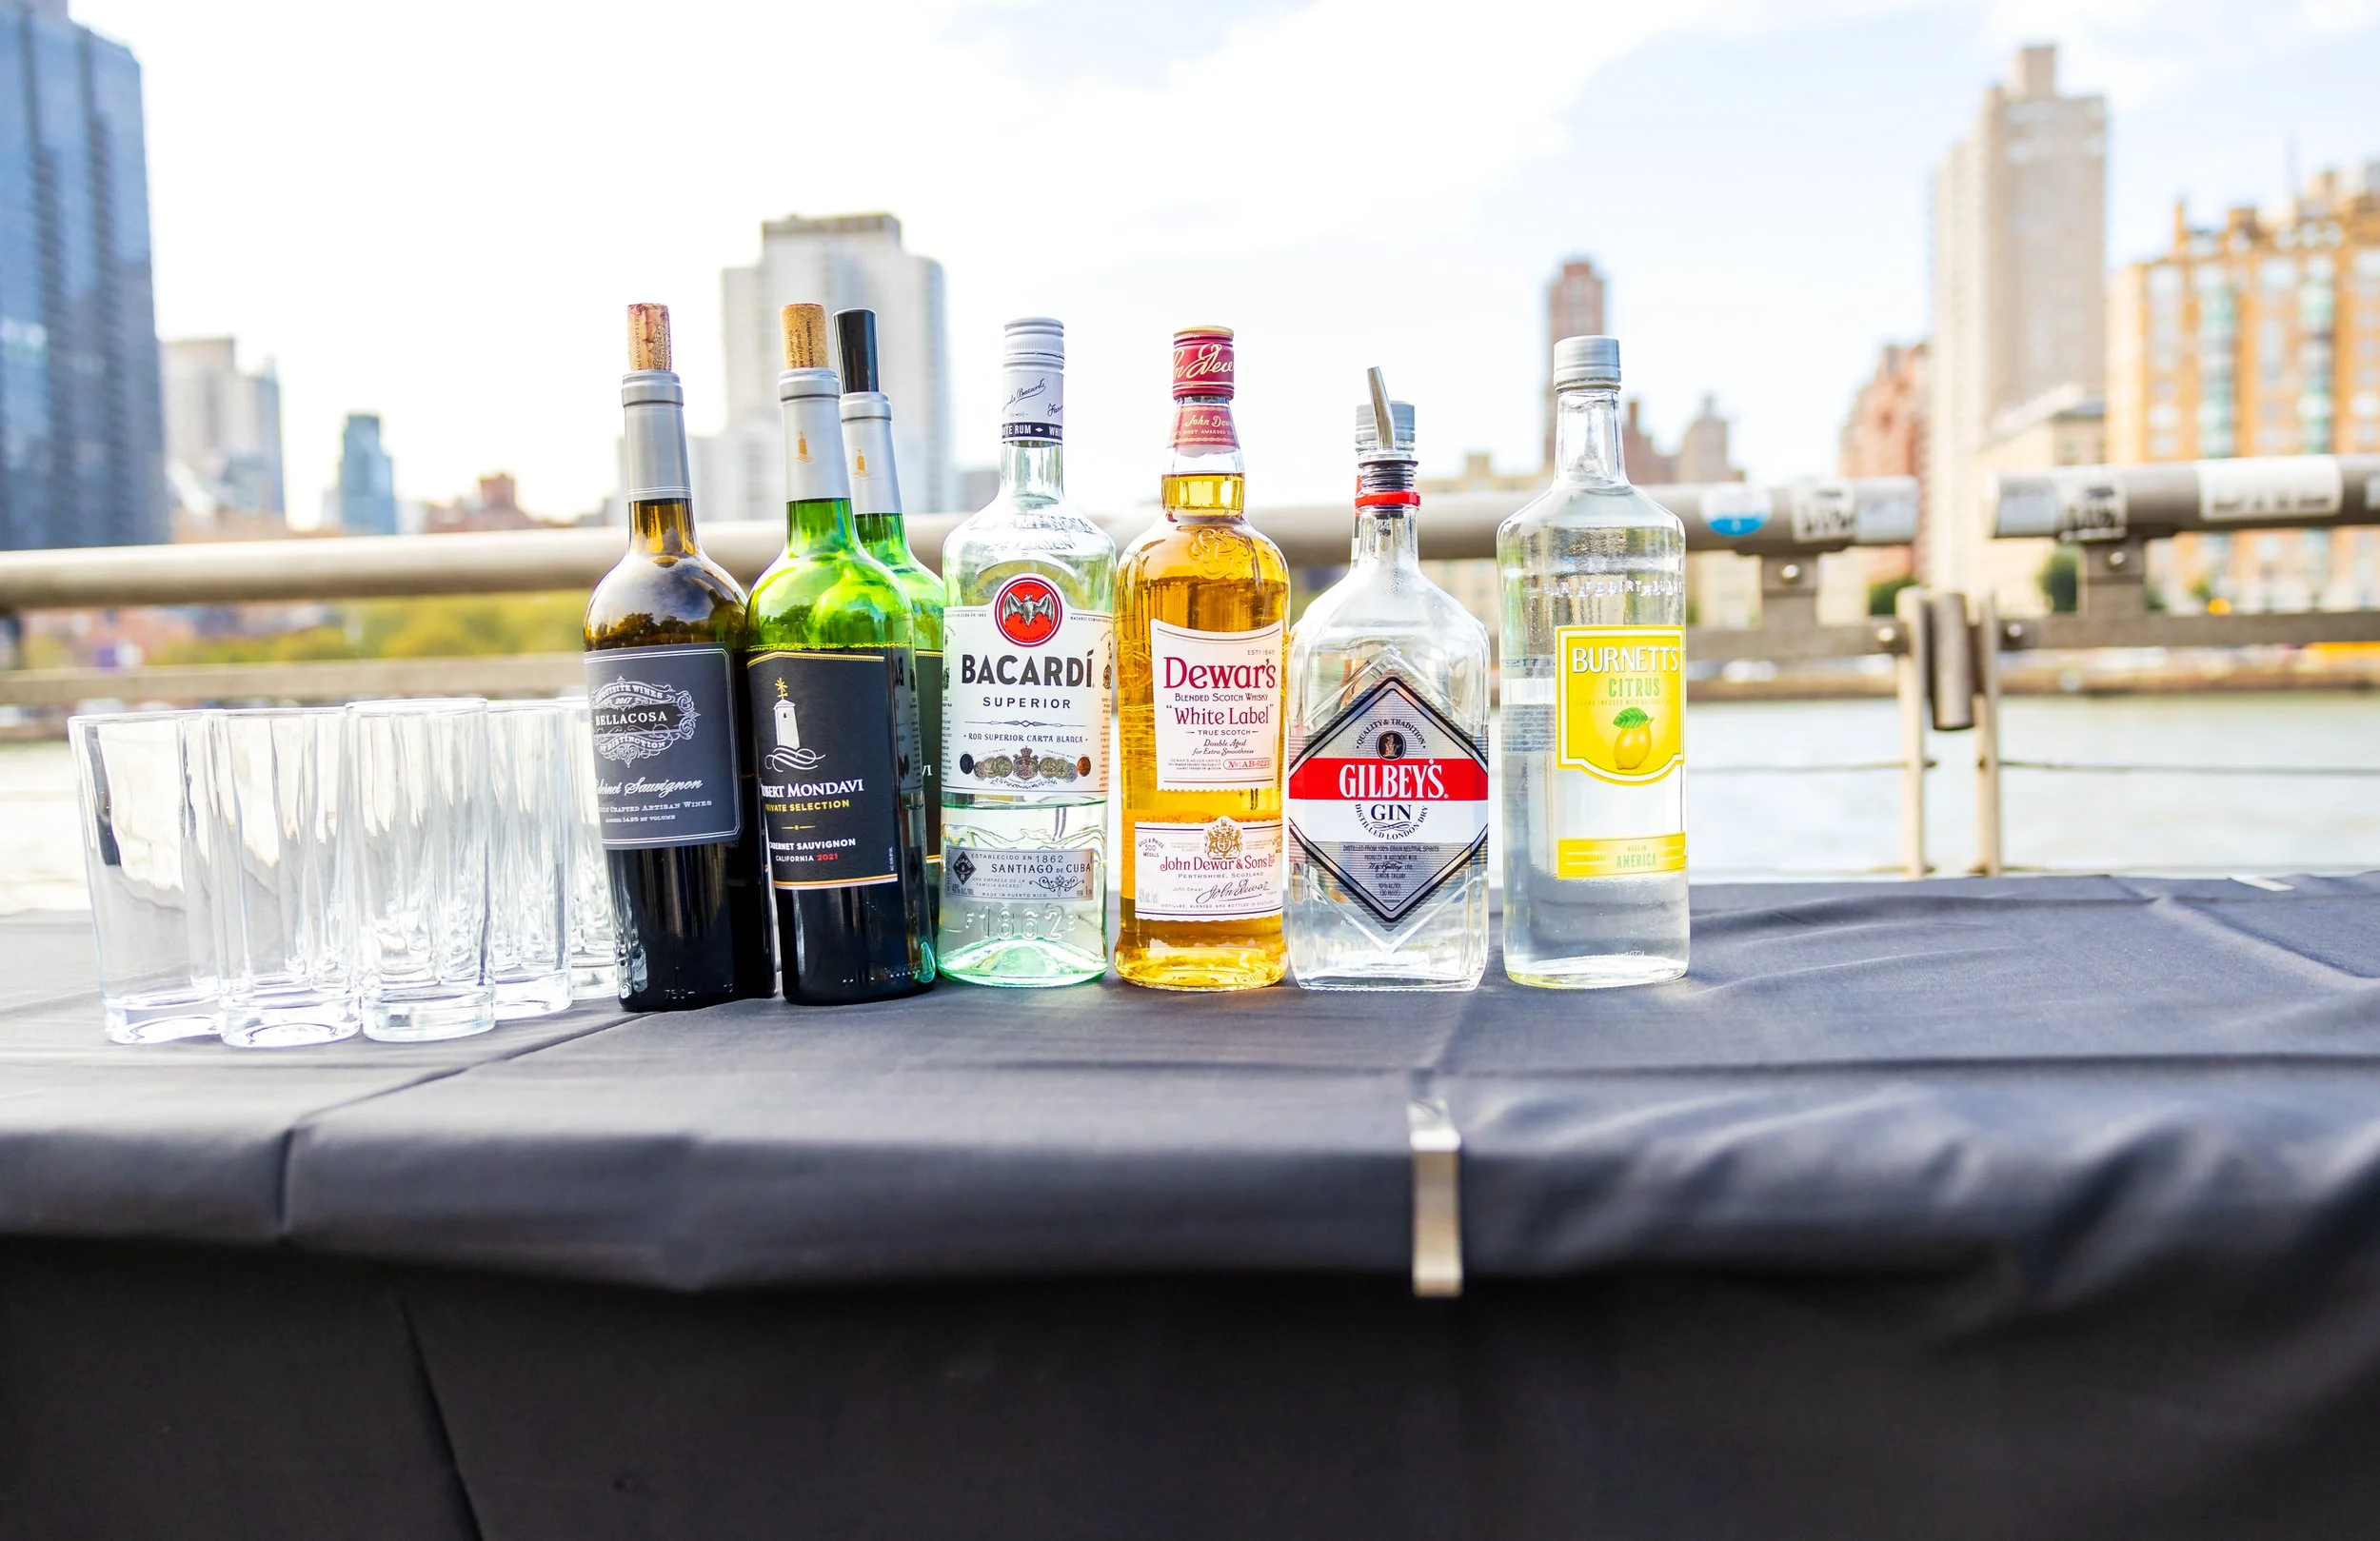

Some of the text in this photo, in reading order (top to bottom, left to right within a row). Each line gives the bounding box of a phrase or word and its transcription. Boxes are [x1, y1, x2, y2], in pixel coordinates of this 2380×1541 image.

[1184, 415, 1210, 426] John
[1014, 425, 1031, 434] RUM
[961, 649, 1095, 688] BACARDÍ
[1163, 657, 1277, 689] Dewar's
[632, 684, 664, 700] WINES
[1608, 678, 1660, 697] CITRUS
[982, 697, 1071, 709] SUPERIOR
[595, 711, 667, 726] BELLACOSA
[984, 734, 1024, 742] SUPERIOR
[1357, 719, 1386, 745] QUALITY
[1391, 719, 1426, 745] TRADITION
[606, 736, 665, 750] DISTINCTION
[1202, 738, 1247, 748] Double Aged
[1191, 747, 1255, 757] for Extra Smoothness
[1339, 759, 1445, 799] GILBEY'S
[624, 777, 703, 798] Sauvignon
[787, 779, 864, 798] MONDAVI
[642, 802, 681, 811] ARTISAN
[789, 800, 850, 811] SELECTION
[1371, 803, 1413, 821] GIN
[1355, 803, 1428, 840] DISTILLED LONDON DRY
[797, 838, 856, 850] SAUVIGNON
[816, 853, 839, 861] 2021
[1036, 855, 1064, 863] 1862
[1160, 856, 1191, 871] John
[1193, 856, 1234, 871] Dewar
[1236, 858, 1243, 870] &
[1244, 855, 1267, 870] Sons
[1616, 853, 1656, 868] AMERICA
[991, 863, 1053, 874] SANTIAGO
[1065, 862, 1091, 873] CUBA
